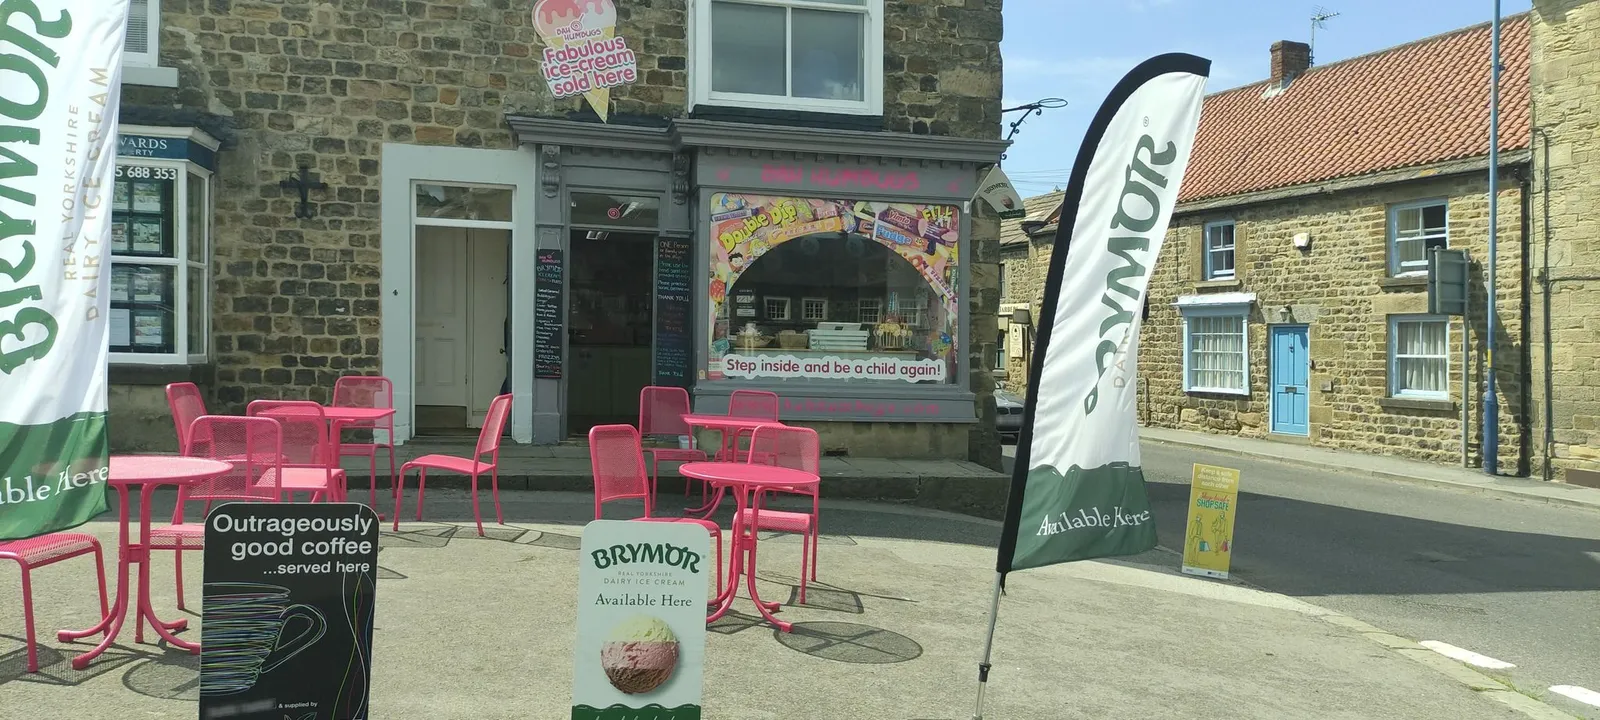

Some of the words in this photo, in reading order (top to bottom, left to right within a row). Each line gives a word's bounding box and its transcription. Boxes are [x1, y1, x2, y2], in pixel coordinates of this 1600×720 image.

[545, 37, 625, 64] Fabulous
[543, 50, 634, 79] ice-cream
[554, 73, 590, 95] sold
[593, 68, 635, 86] here
[87, 67, 108, 161] CREAM
[62, 104, 78, 223] YORKSHIRE
[127, 166, 150, 178] 688
[153, 167, 177, 180] 353
[82, 176, 102, 220] ICE
[719, 213, 770, 255] Double
[769, 203, 797, 226] Dip
[888, 210, 911, 225] Vimto
[876, 227, 912, 245] Fudge
[63, 231, 77, 281] REAL
[82, 236, 100, 321] DAIRY
[726, 358, 757, 374] Step
[761, 359, 800, 372] inside
[804, 360, 830, 373] and
[834, 361, 851, 374] be
[854, 365, 863, 374] a
[866, 362, 896, 375] child
[900, 364, 941, 378] again!
[55, 464, 109, 496] Here
[213, 513, 373, 536] Outrageously
[1036, 506, 1111, 536] Available
[1113, 506, 1150, 528] Here
[231, 538, 294, 561] good
[301, 537, 372, 555] coffee
[591, 542, 700, 574] BRYMOR
[263, 560, 331, 575] ...served
[336, 560, 370, 574] here
[604, 577, 632, 585] DAIRY
[595, 593, 656, 606] Available
[661, 594, 692, 607] Here
[284, 701, 310, 709] supplied
